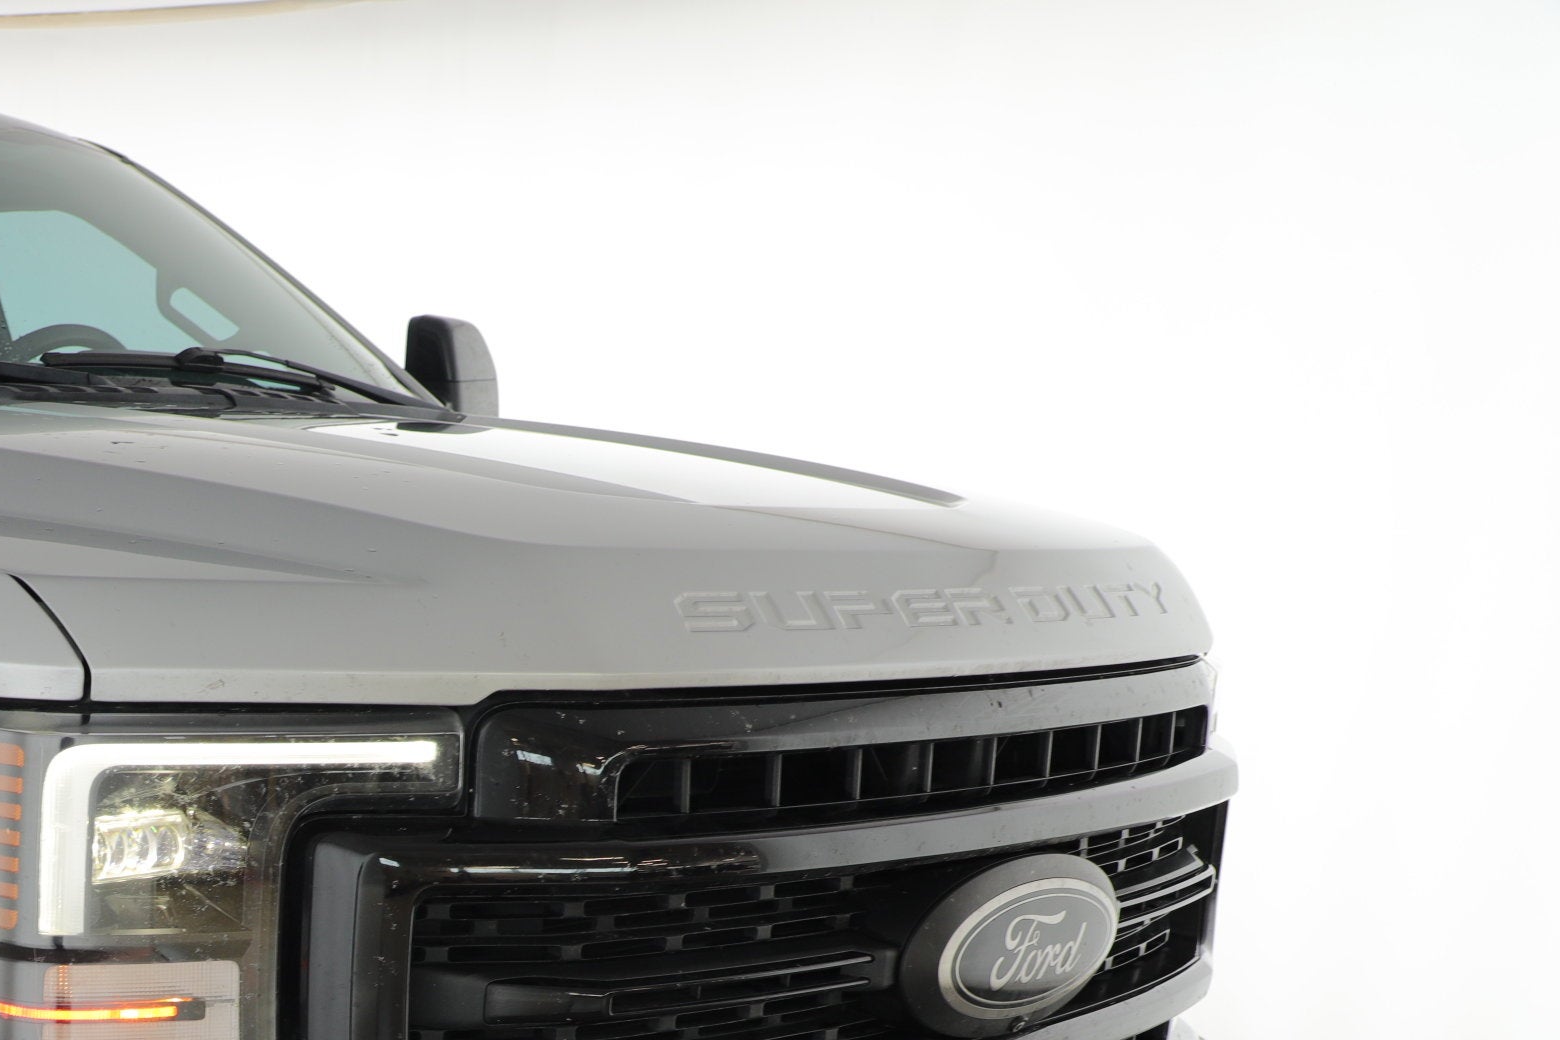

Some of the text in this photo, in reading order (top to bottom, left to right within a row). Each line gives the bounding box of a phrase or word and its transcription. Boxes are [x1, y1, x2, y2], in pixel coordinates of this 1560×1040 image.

[675, 581, 1169, 633] SUPER DUTY
[990, 910, 1087, 991] Ford
